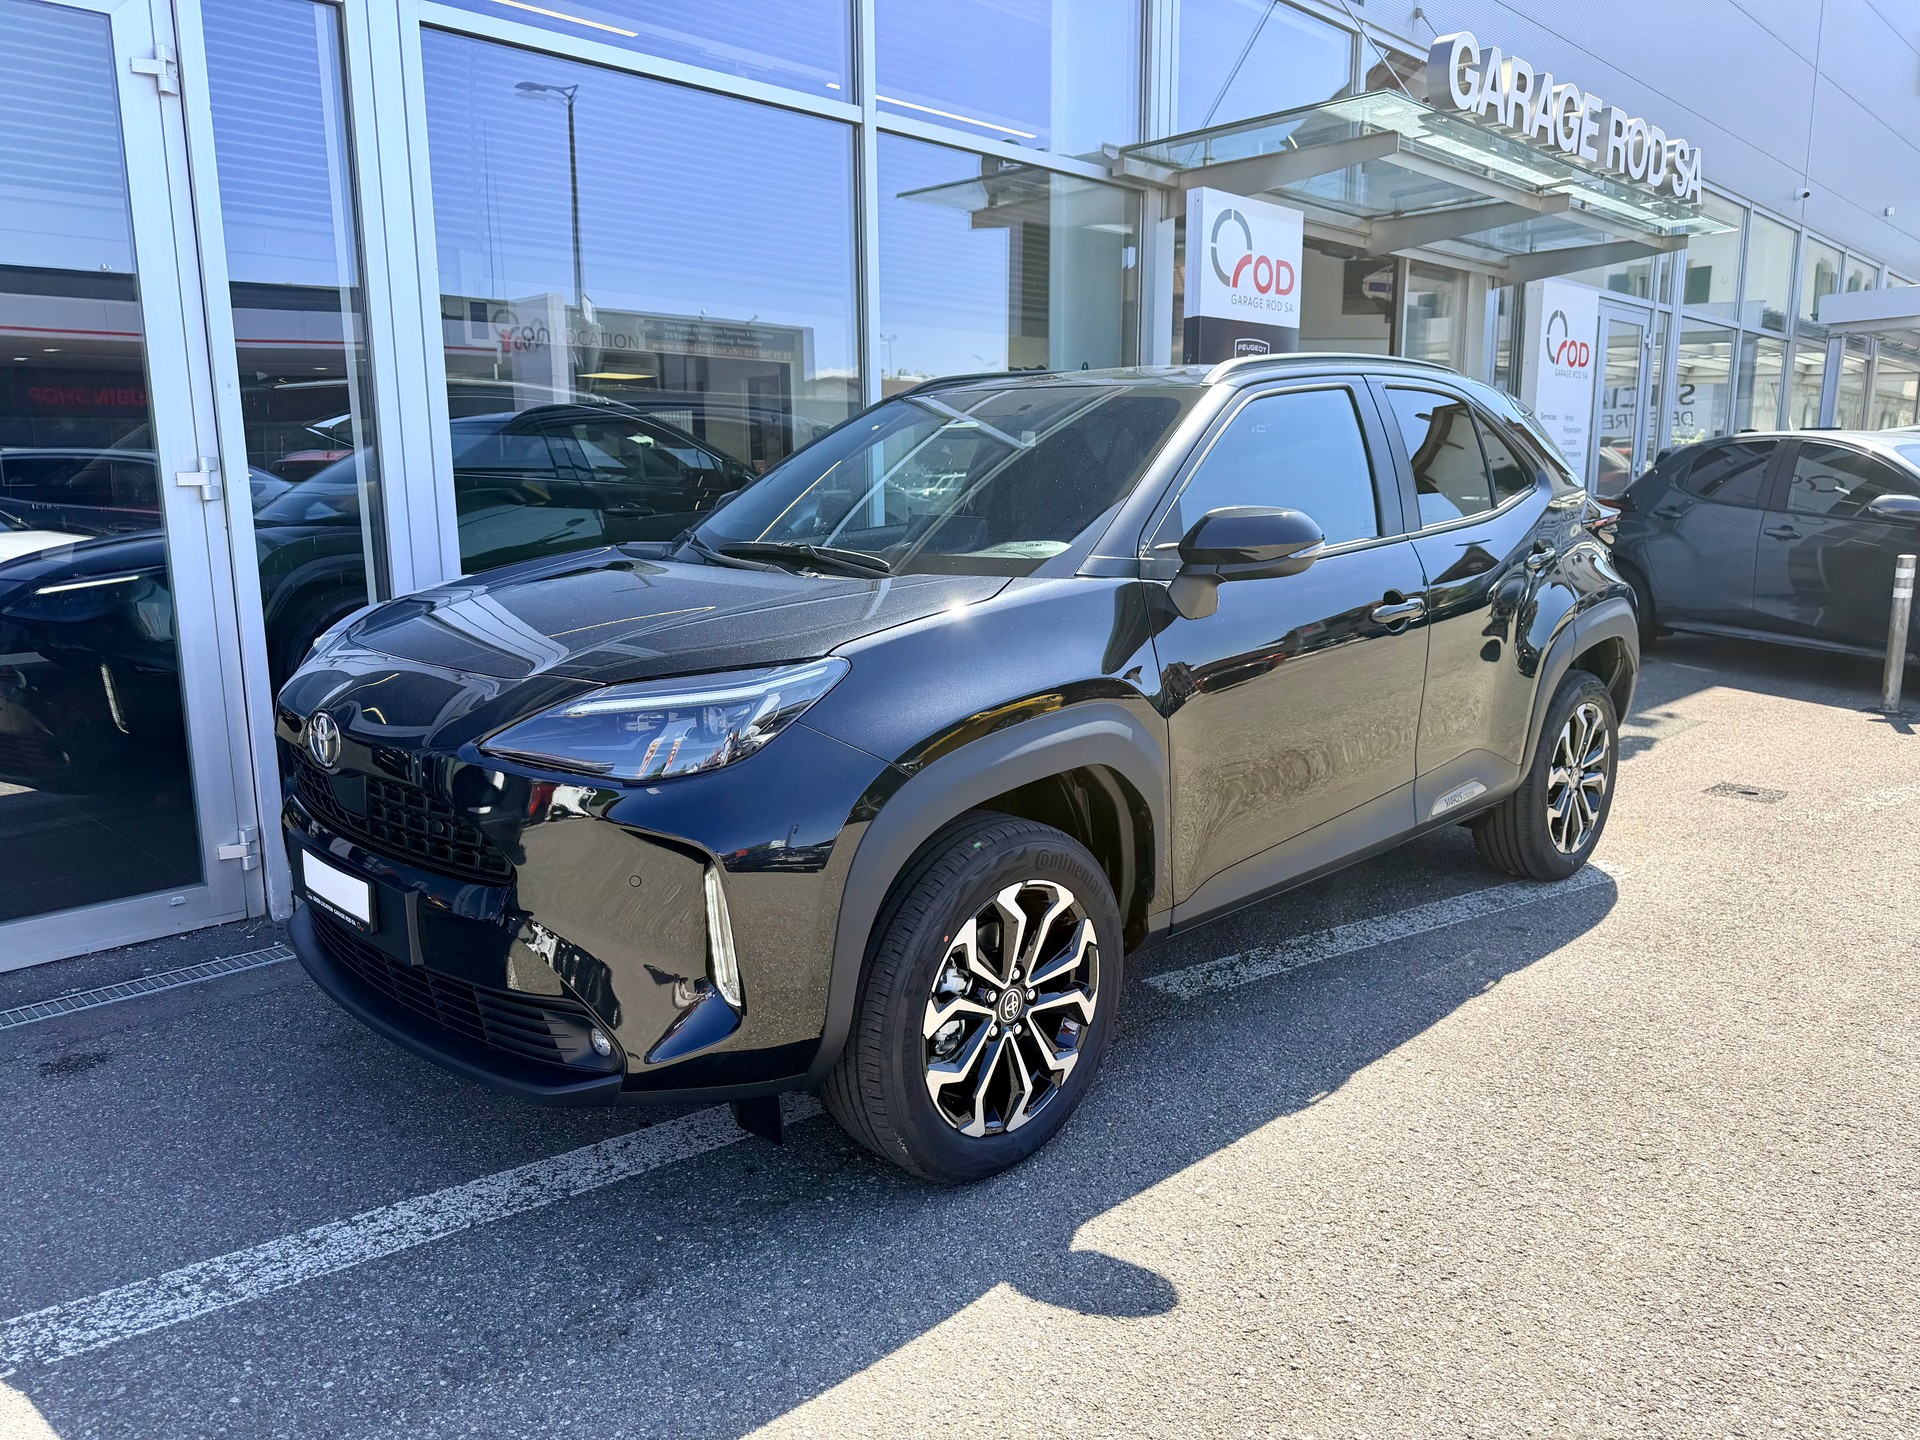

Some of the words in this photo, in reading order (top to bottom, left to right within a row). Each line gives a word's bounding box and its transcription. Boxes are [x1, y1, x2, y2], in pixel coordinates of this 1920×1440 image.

[1436, 31, 1603, 162] GARAGE
[1606, 105, 1667, 187] ROD
[1671, 138, 1702, 205] SA
[1231, 294, 1264, 309] GARAGE
[1266, 299, 1282, 312] ROD
[1284, 302, 1294, 314] SA
[1237, 344, 1267, 353] PEUGEOT
[1555, 368, 1572, 379] GARAGE
[1572, 370, 1582, 379] ROD
[1034, 848, 1103, 897] Continental
